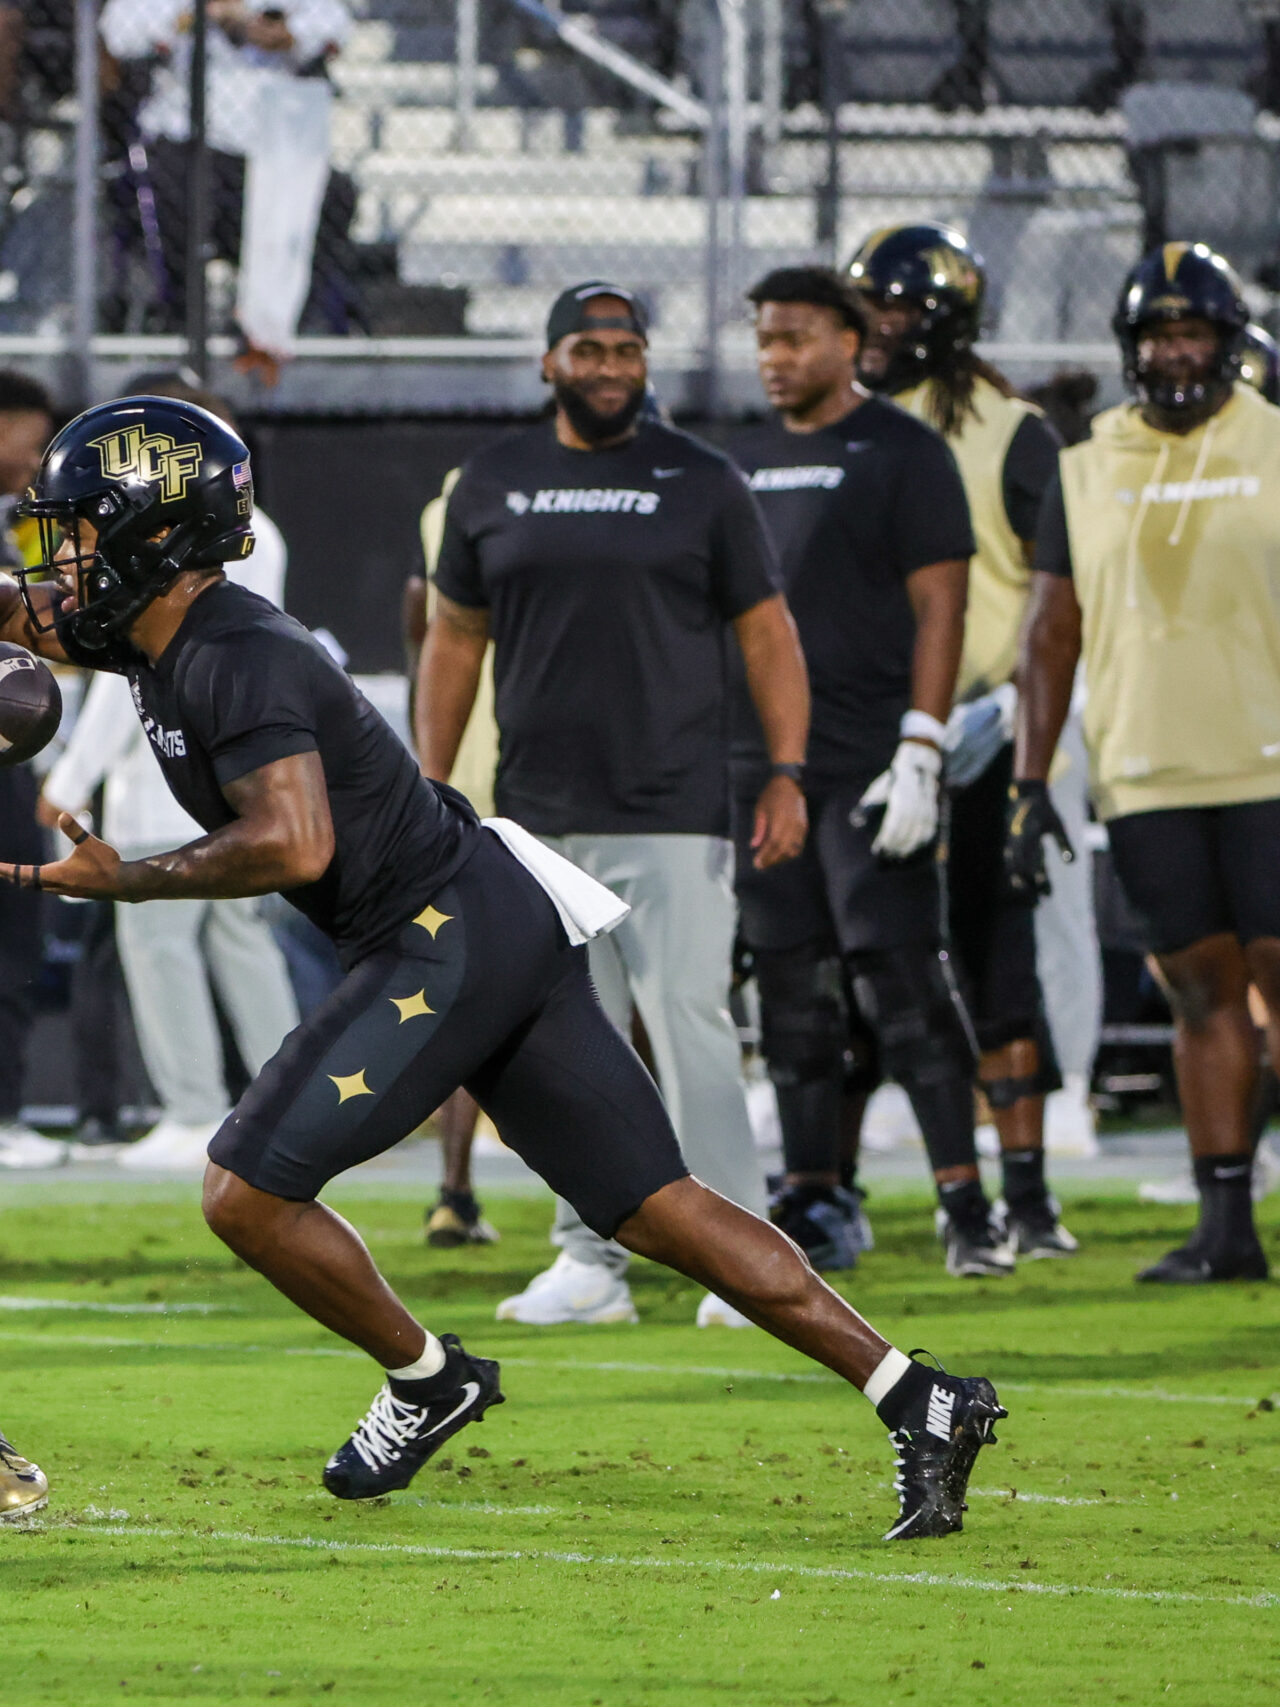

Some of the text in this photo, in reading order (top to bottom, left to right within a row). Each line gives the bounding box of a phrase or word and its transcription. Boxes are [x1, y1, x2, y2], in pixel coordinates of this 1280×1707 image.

[86, 424, 202, 503] UCF
[531, 489, 660, 514] KNIGHTS
[925, 1383, 956, 1442] NIKE
